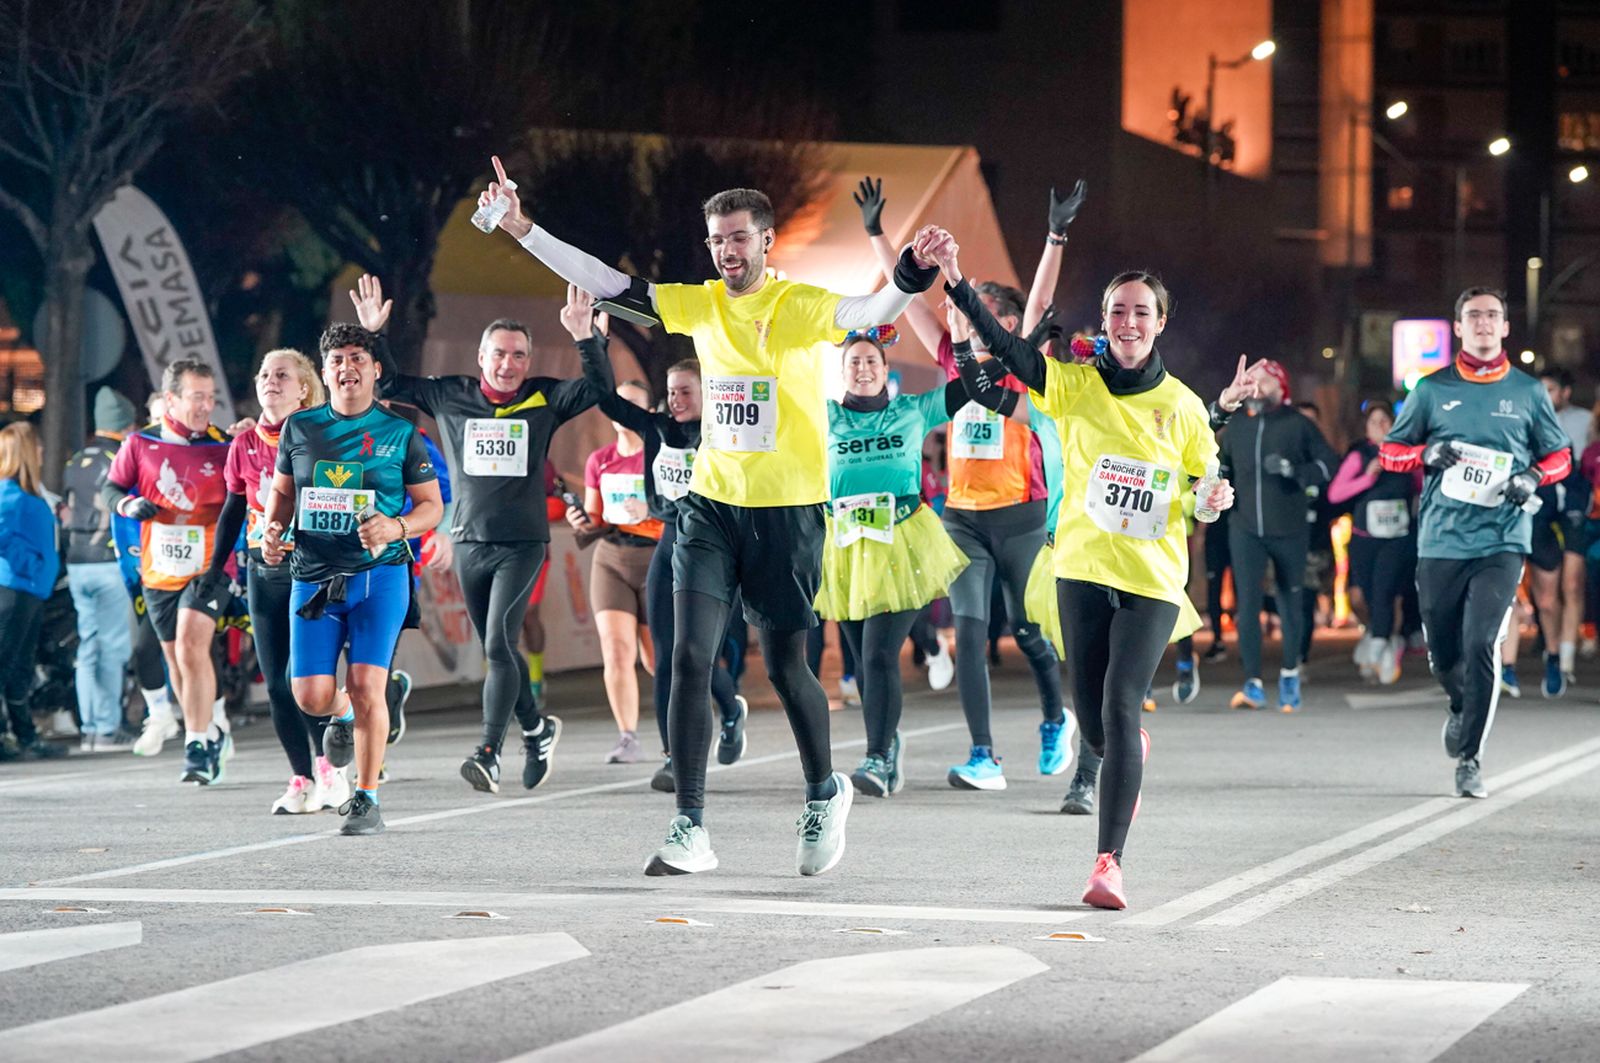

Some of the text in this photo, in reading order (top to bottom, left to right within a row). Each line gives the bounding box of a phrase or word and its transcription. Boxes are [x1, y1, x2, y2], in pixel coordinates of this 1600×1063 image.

[736, 384, 745, 392] DE
[716, 402, 759, 426] 3709
[475, 440, 516, 456] 5330
[837, 432, 904, 455] serás
[660, 464, 692, 484] 5329
[1099, 470, 1116, 482] SAN
[1110, 464, 1136, 476] NOCHE
[1136, 468, 1147, 478] DE
[1463, 466, 1493, 486] 667
[307, 502, 323, 510] SAN
[1104, 483, 1154, 513] 3710
[309, 510, 352, 531] 1387
[850, 507, 875, 524] 131
[161, 543, 192, 560] 1952
